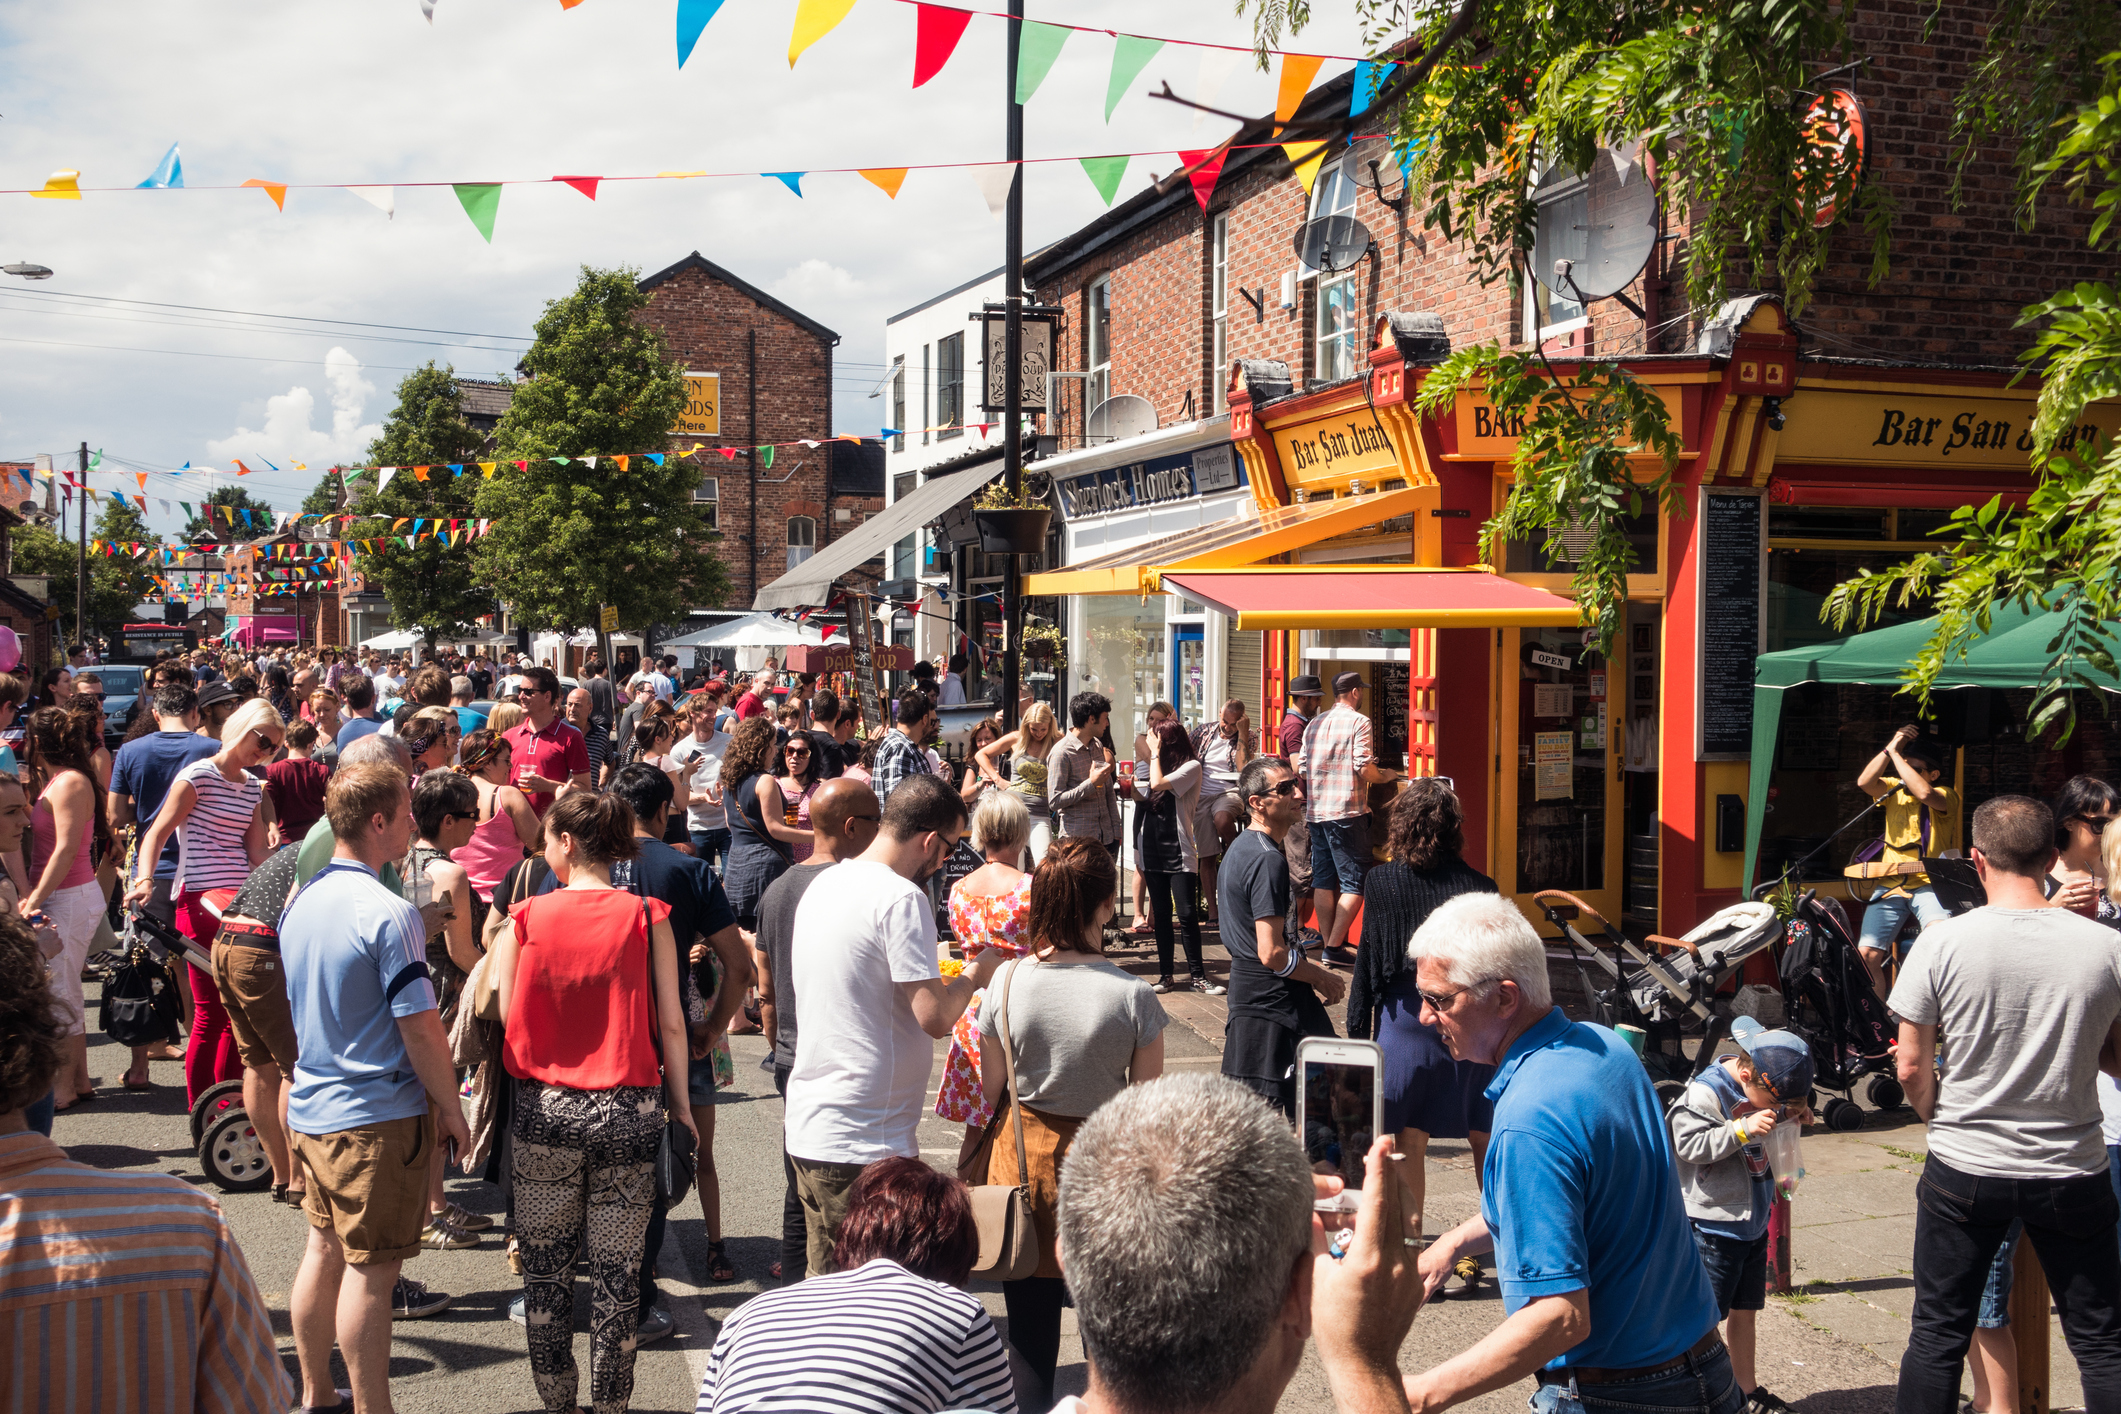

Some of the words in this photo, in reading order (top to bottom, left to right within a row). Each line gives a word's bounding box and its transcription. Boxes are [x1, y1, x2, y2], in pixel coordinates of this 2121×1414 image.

[678, 419, 706, 431] Here
[1474, 406, 1528, 437] BAR
[1872, 409, 1942, 446] Bar
[1942, 412, 2012, 455] San
[1290, 439, 1319, 471] Bar
[1319, 428, 1350, 470] San
[1346, 422, 1390, 456] Juan
[1195, 452, 1229, 472] Properties
[1209, 470, 1220, 485] Ltd
[1064, 468, 1132, 515] Sherlock
[1129, 463, 1192, 503] Homes
[1538, 654, 1564, 667] OPEN
[959, 853, 971, 861] AND
[950, 864, 974, 872] DRINKS
